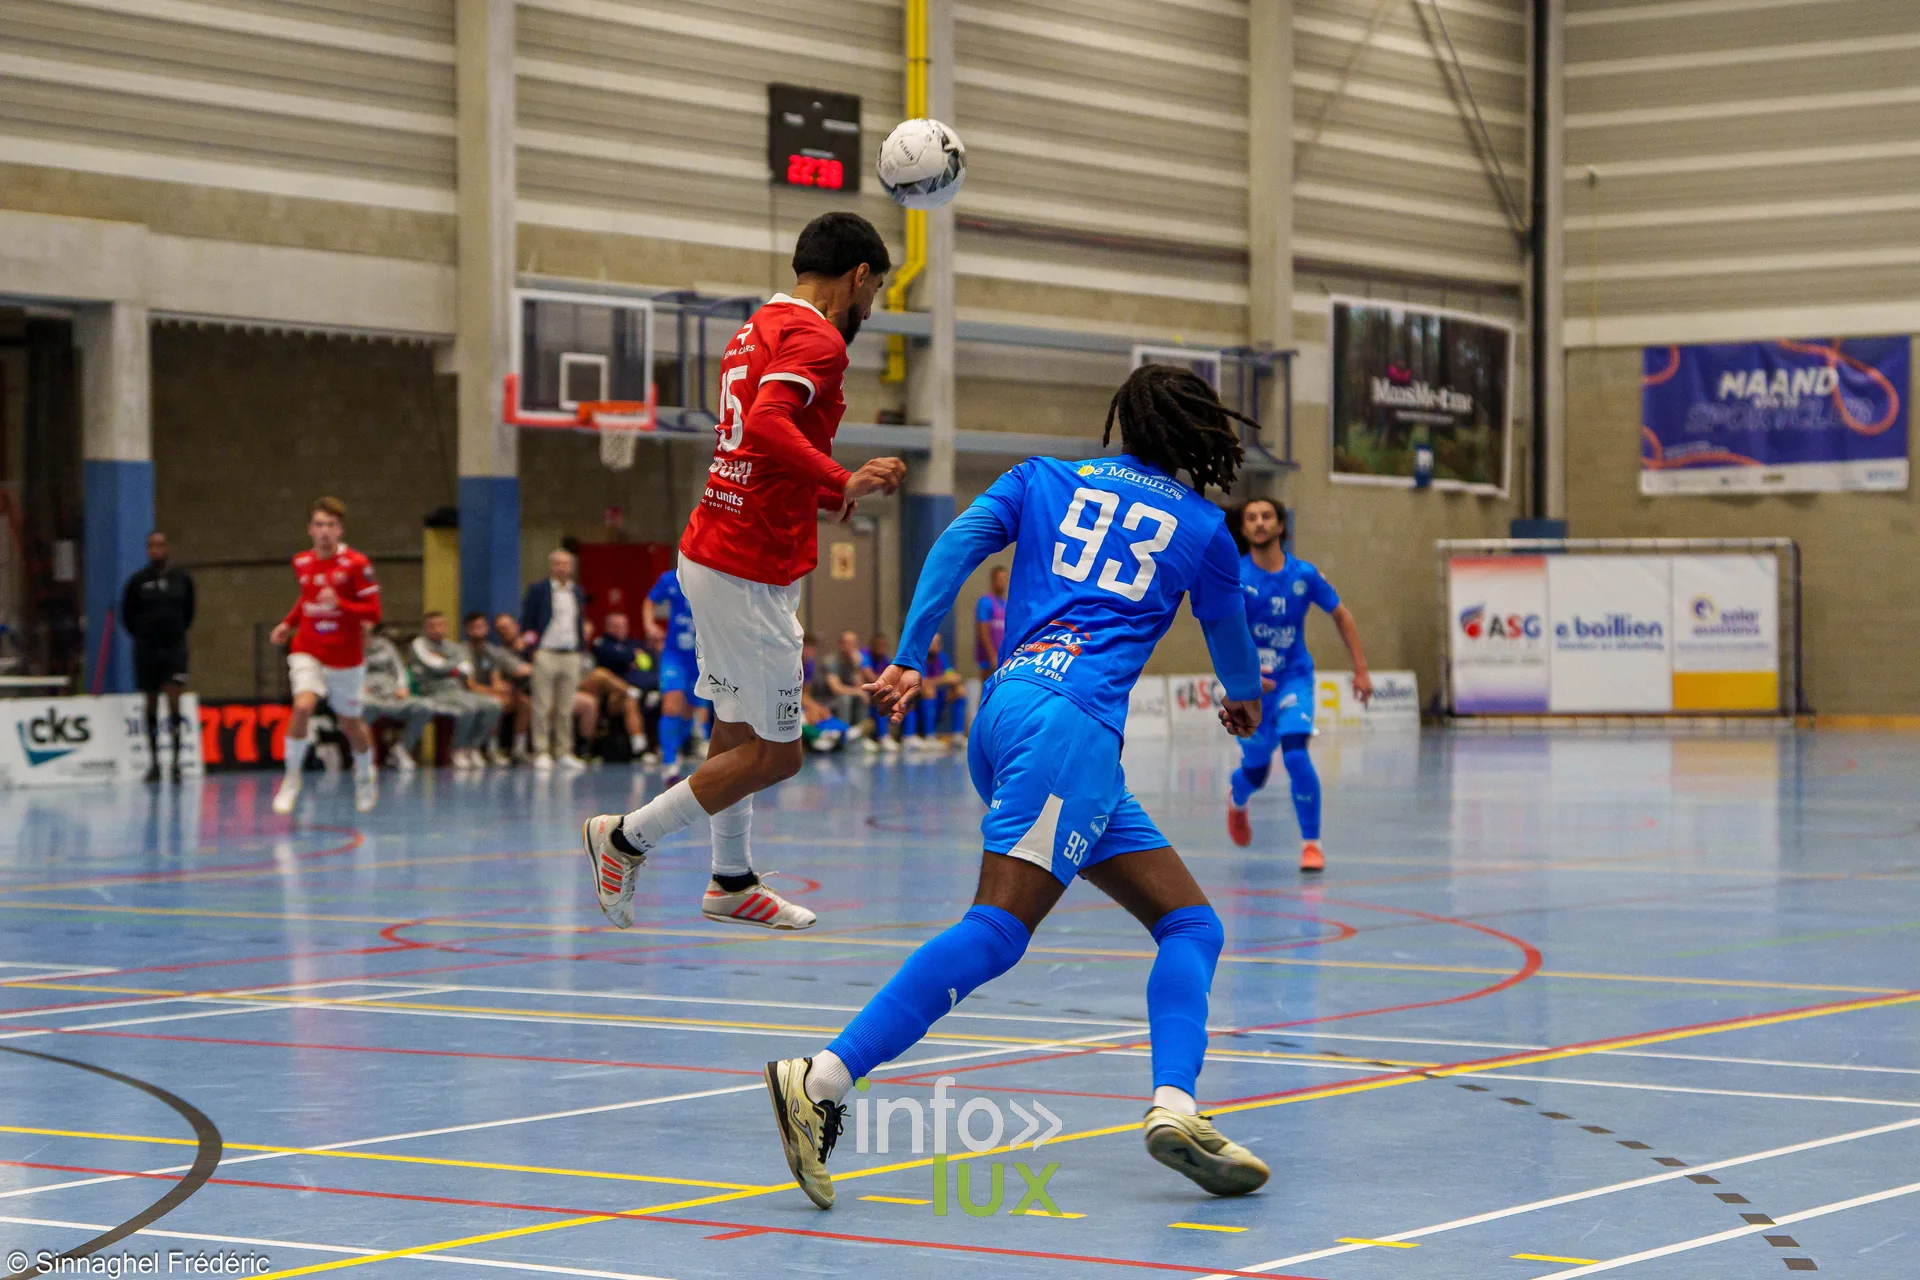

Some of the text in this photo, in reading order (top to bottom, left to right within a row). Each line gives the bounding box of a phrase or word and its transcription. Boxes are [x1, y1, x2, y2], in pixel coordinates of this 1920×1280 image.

[898, 139, 915, 162] KIPSTA
[1718, 366, 1839, 397] MAAND
[715, 366, 749, 452] 15
[1107, 466, 1164, 490] Martin
[708, 501, 723, 509] your
[715, 490, 744, 507] units
[1051, 487, 1179, 603] 93
[1488, 614, 1542, 639] ASG
[1044, 669, 1064, 683] Fils
[30, 707, 90, 744] cks
[1063, 830, 1089, 867] 93
